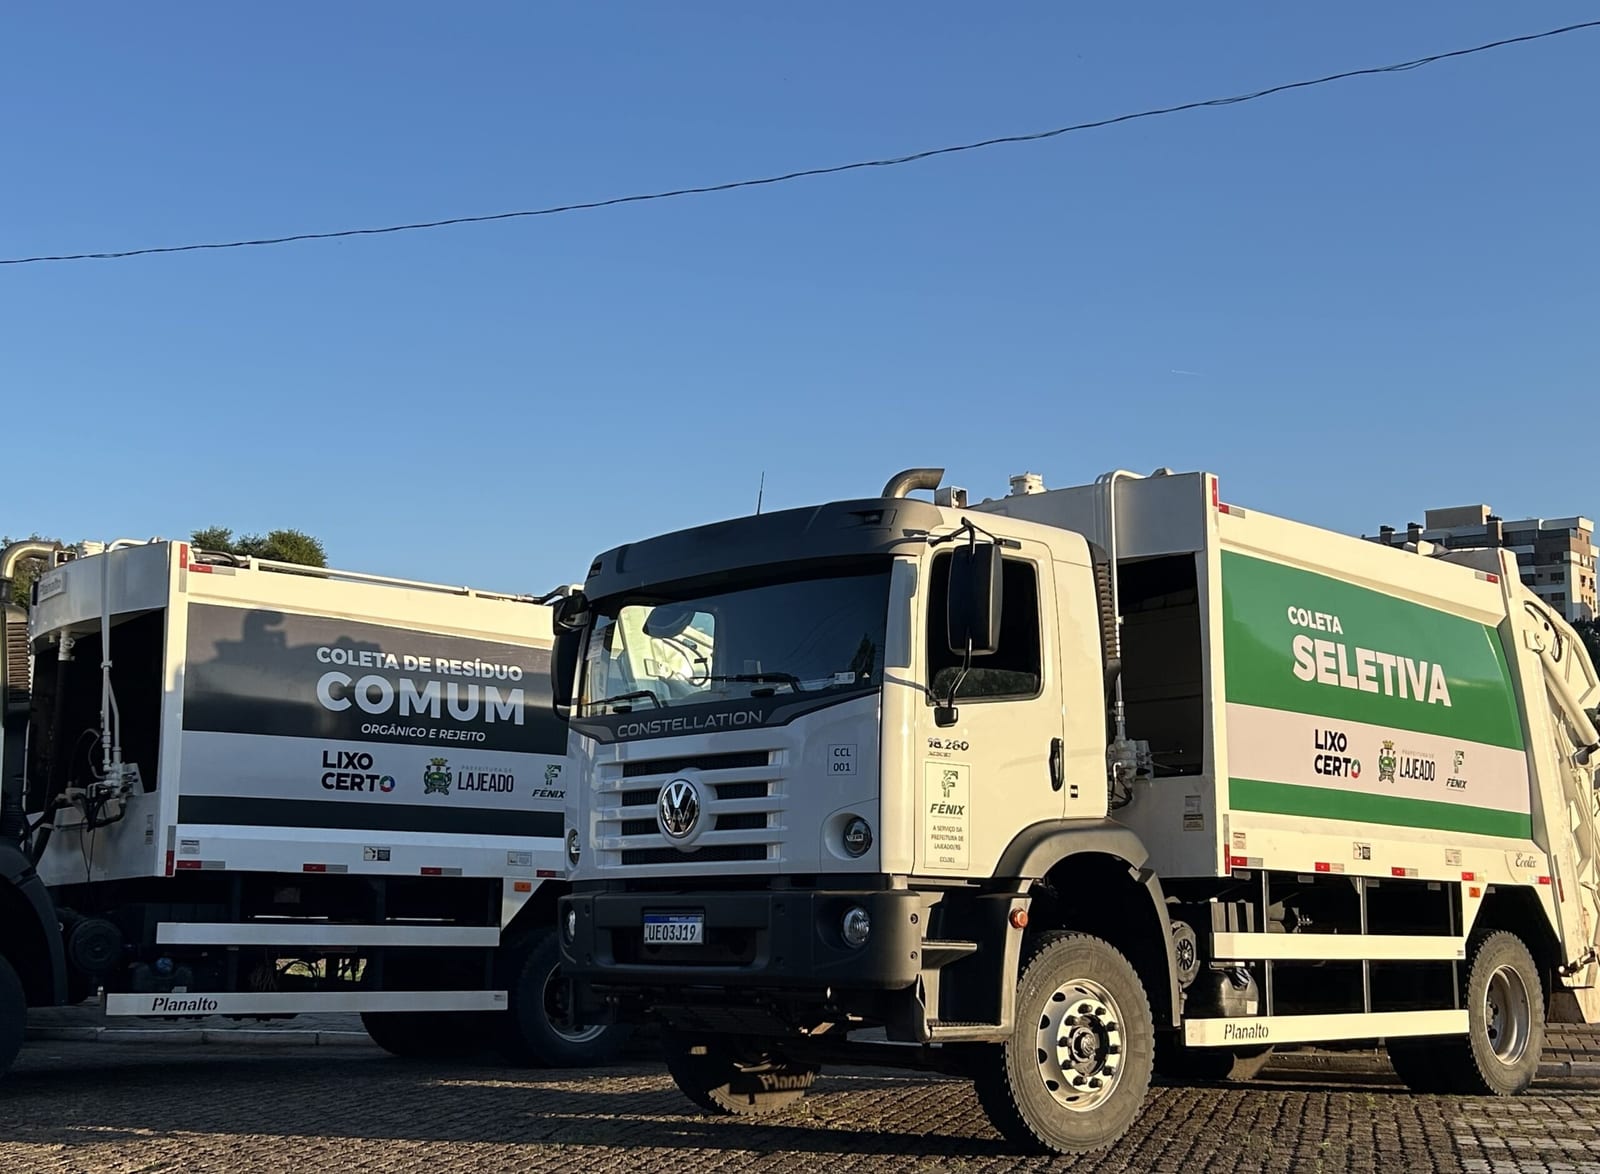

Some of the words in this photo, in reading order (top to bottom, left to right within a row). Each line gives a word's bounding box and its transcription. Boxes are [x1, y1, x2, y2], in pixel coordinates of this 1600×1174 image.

[1287, 605, 1344, 635] COLETA
[316, 646, 399, 670] COLETA
[403, 654, 431, 673] DE
[436, 658, 523, 682] RESÍDUO
[1292, 634, 1452, 707] SELETIVA
[316, 671, 525, 726] COMUM
[361, 723, 426, 738] ORGÂNICO
[429, 728, 437, 738] E
[438, 730, 486, 742] REJEITO
[616, 709, 763, 738] CONSTELLATION
[1315, 728, 1347, 753] LIXO
[322, 750, 374, 770] LIXO
[834, 748, 852, 758] CCL
[833, 763, 850, 772] 001
[1314, 754, 1361, 779] CERTO
[1399, 756, 1436, 782] LAJEADO
[321, 772, 395, 792] CERTO
[457, 771, 514, 793] LAJEADO
[152, 997, 218, 1011] Planalto
[1224, 1022, 1269, 1040] Planalto
